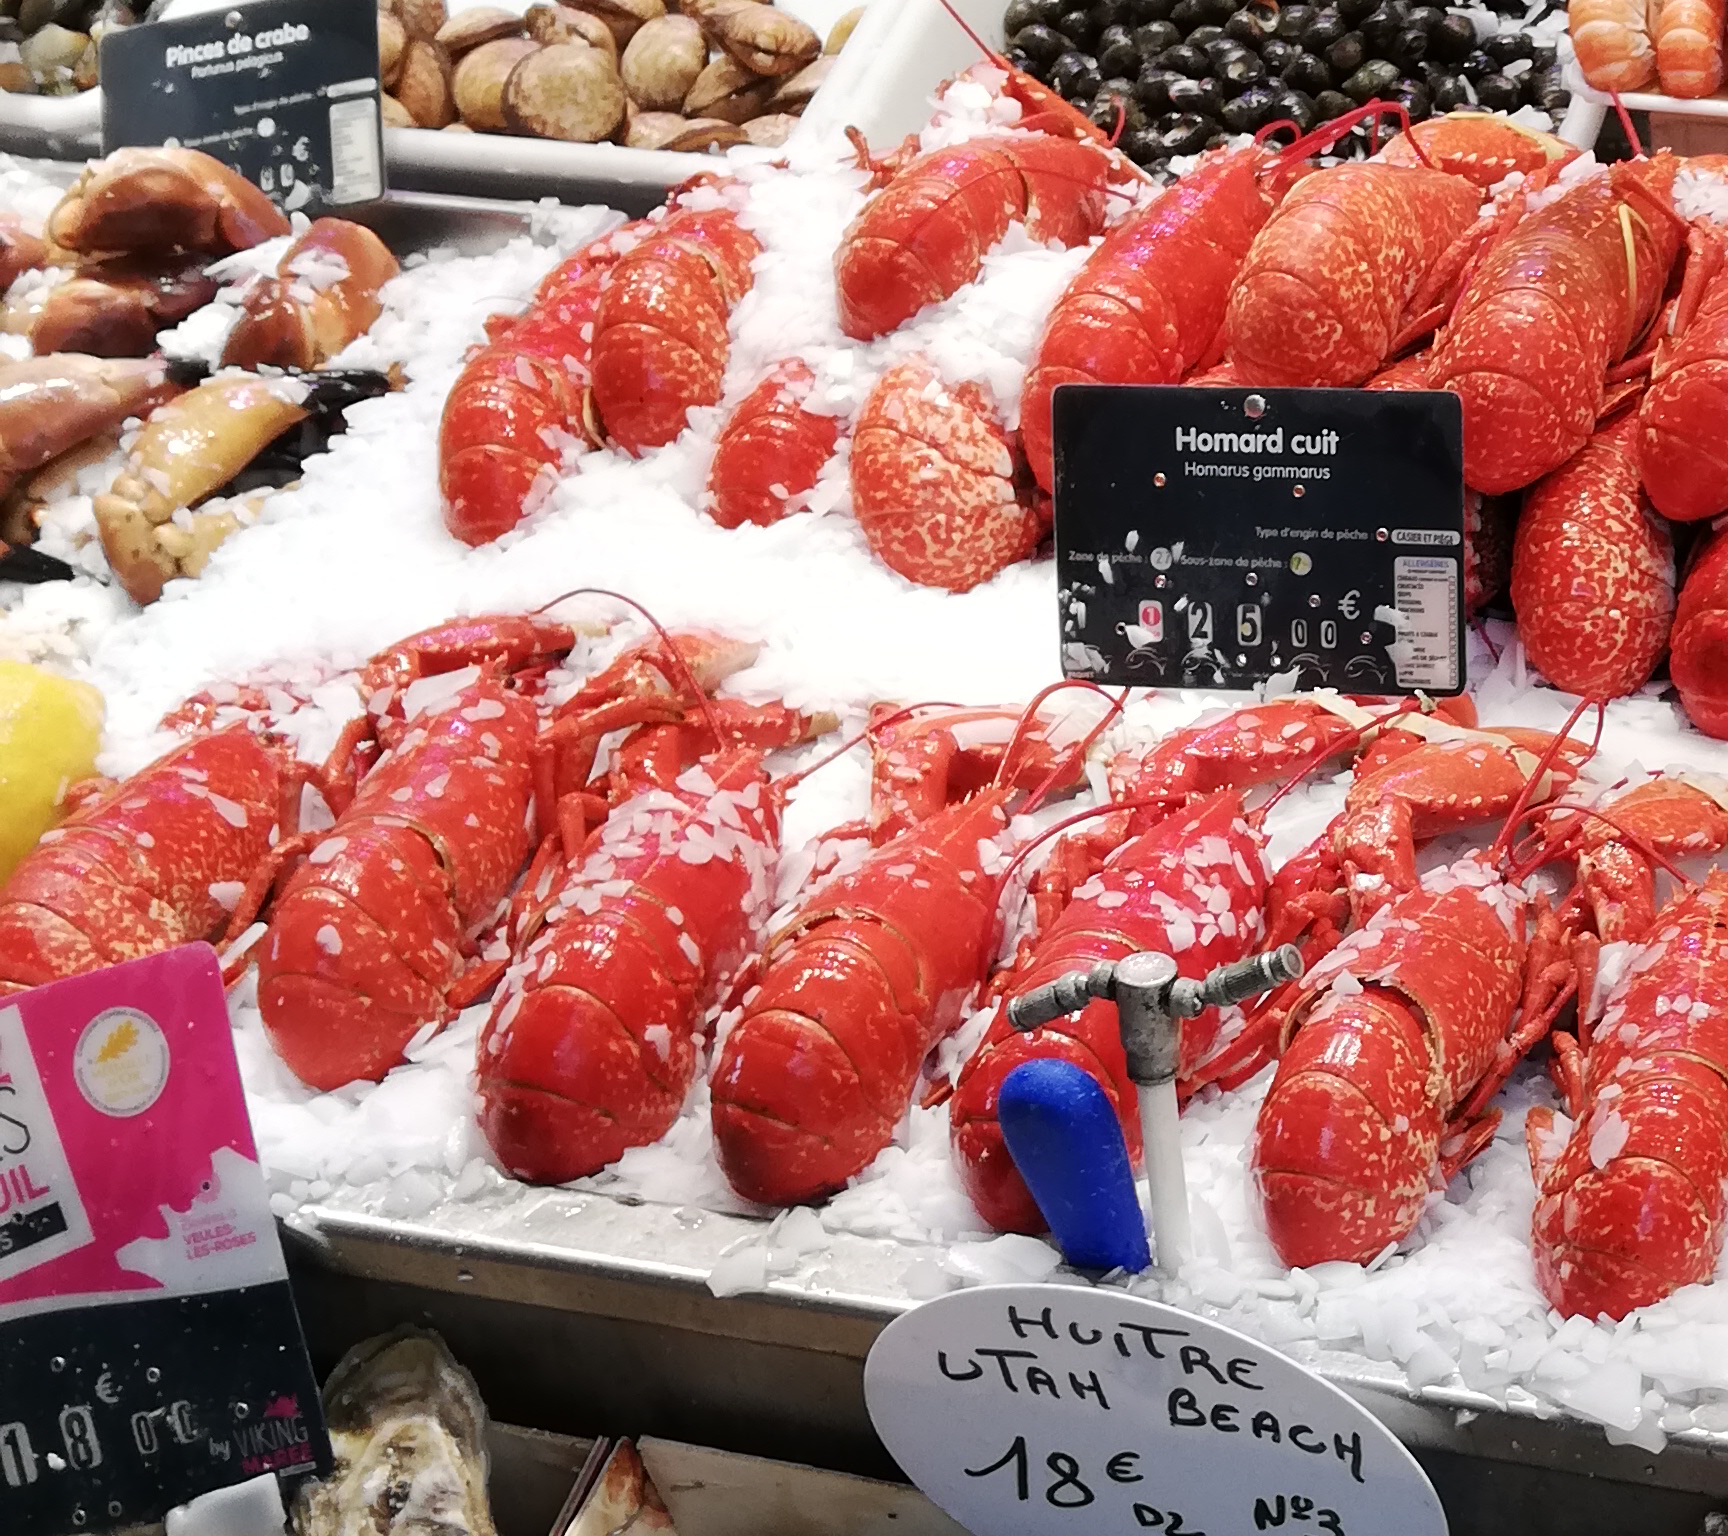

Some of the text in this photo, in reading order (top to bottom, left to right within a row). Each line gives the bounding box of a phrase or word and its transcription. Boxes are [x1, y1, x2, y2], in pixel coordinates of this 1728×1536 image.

[166, 41, 225, 67] Pinces
[227, 32, 253, 55] de
[255, 22, 310, 49] crabe
[1176, 425, 1340, 456] Homard cuit
[1184, 462, 1331, 482] Homarus gammarus
[1255, 527, 1278, 540] Type
[1321, 528, 1335, 539] de
[1397, 531, 1422, 543] CASIER
[1423, 533, 1432, 543] ET
[1068, 550, 1094, 561] Zone
[1235, 556, 1249, 567] de
[1338, 589, 1361, 620] €
[1008, 1305, 1264, 1391] HUITRE
[95, 1372, 123, 1404] €
[938, 1348, 1365, 1483] UTAH BEACH
[233, 1416, 308, 1457] VIKING
